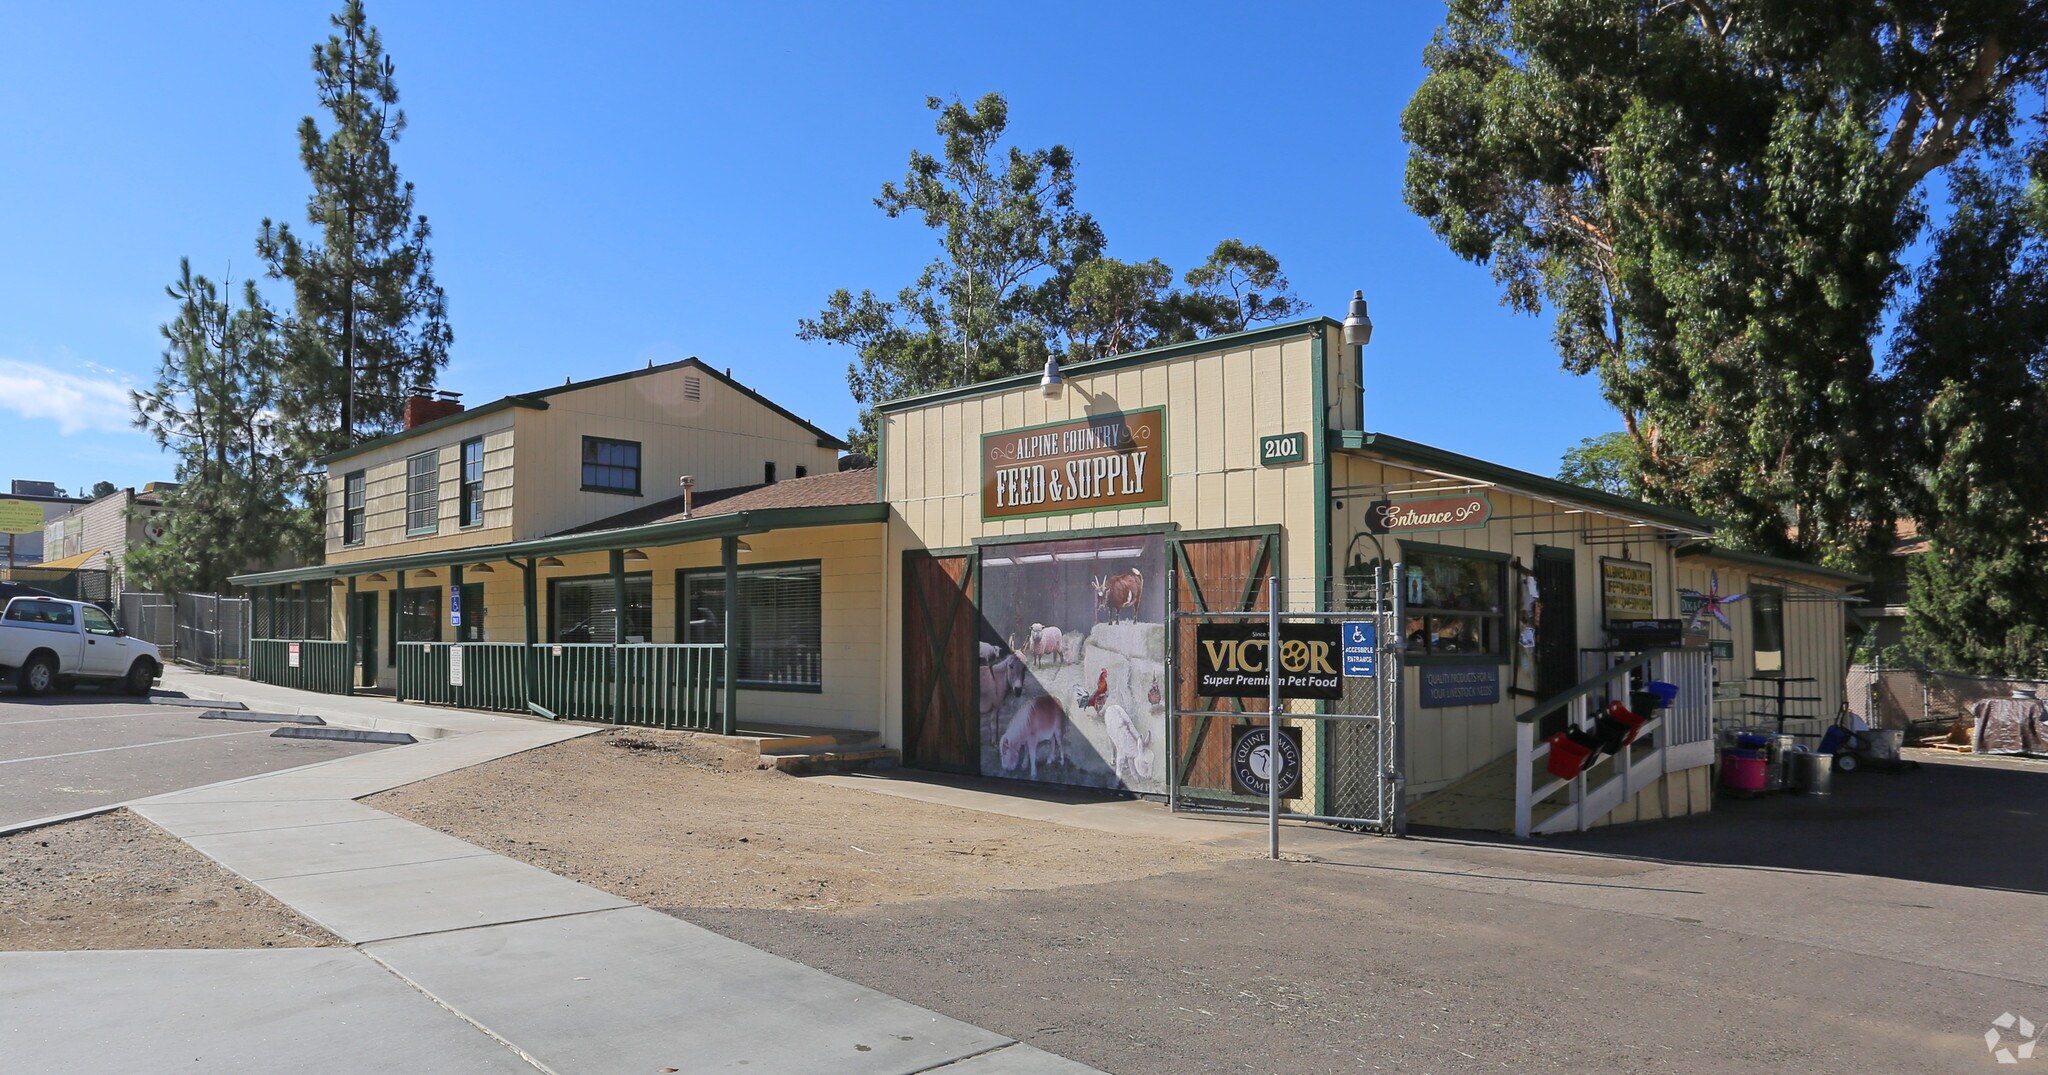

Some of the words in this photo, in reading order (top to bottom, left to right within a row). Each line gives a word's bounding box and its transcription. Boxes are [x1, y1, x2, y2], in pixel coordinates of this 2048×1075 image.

[1016, 432, 1059, 460] ALPINE
[1063, 423, 1120, 453] COUNTRY
[1265, 437, 1298, 458] 2101
[996, 464, 1046, 508] FEED
[1049, 469, 1063, 502] &
[1066, 451, 1147, 501] SUPPLY
[1376, 505, 1454, 529] Entrance
[1202, 639, 1337, 674] VICTOR
[1345, 646, 1374, 654] ACCESSIBLE
[1347, 655, 1372, 663] ENTRANCE
[1203, 674, 1234, 686] Super
[1236, 674, 1286, 687] Premim
[1288, 675, 1307, 687] Pet
[1308, 676, 1338, 688] Food
[1237, 733, 1266, 763] EQUINE
[1276, 737, 1297, 767] MEGA
[1240, 768, 1295, 792] COMPETE
